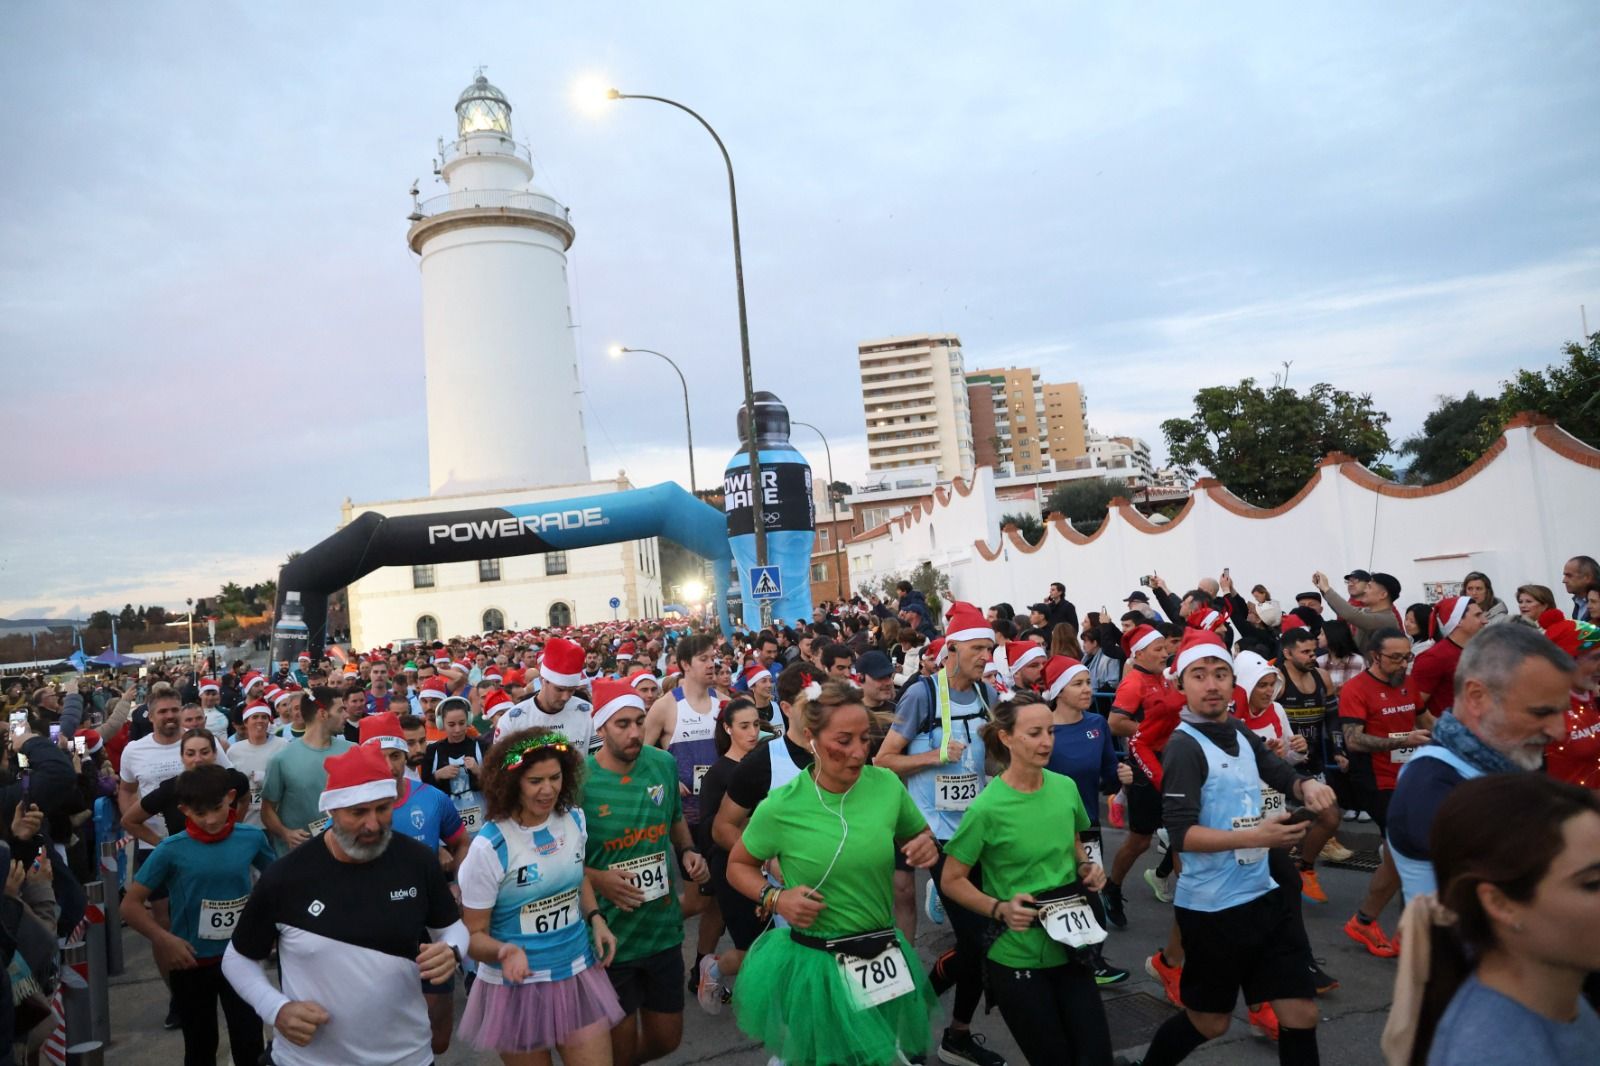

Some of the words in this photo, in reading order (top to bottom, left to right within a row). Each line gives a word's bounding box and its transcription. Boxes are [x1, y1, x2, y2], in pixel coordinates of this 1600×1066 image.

[428, 507, 602, 544] POWERADE
[941, 784, 976, 800] 1323
[630, 865, 663, 889] 094
[536, 905, 570, 934] 677
[1057, 910, 1091, 933] 781
[855, 955, 897, 989] 780
